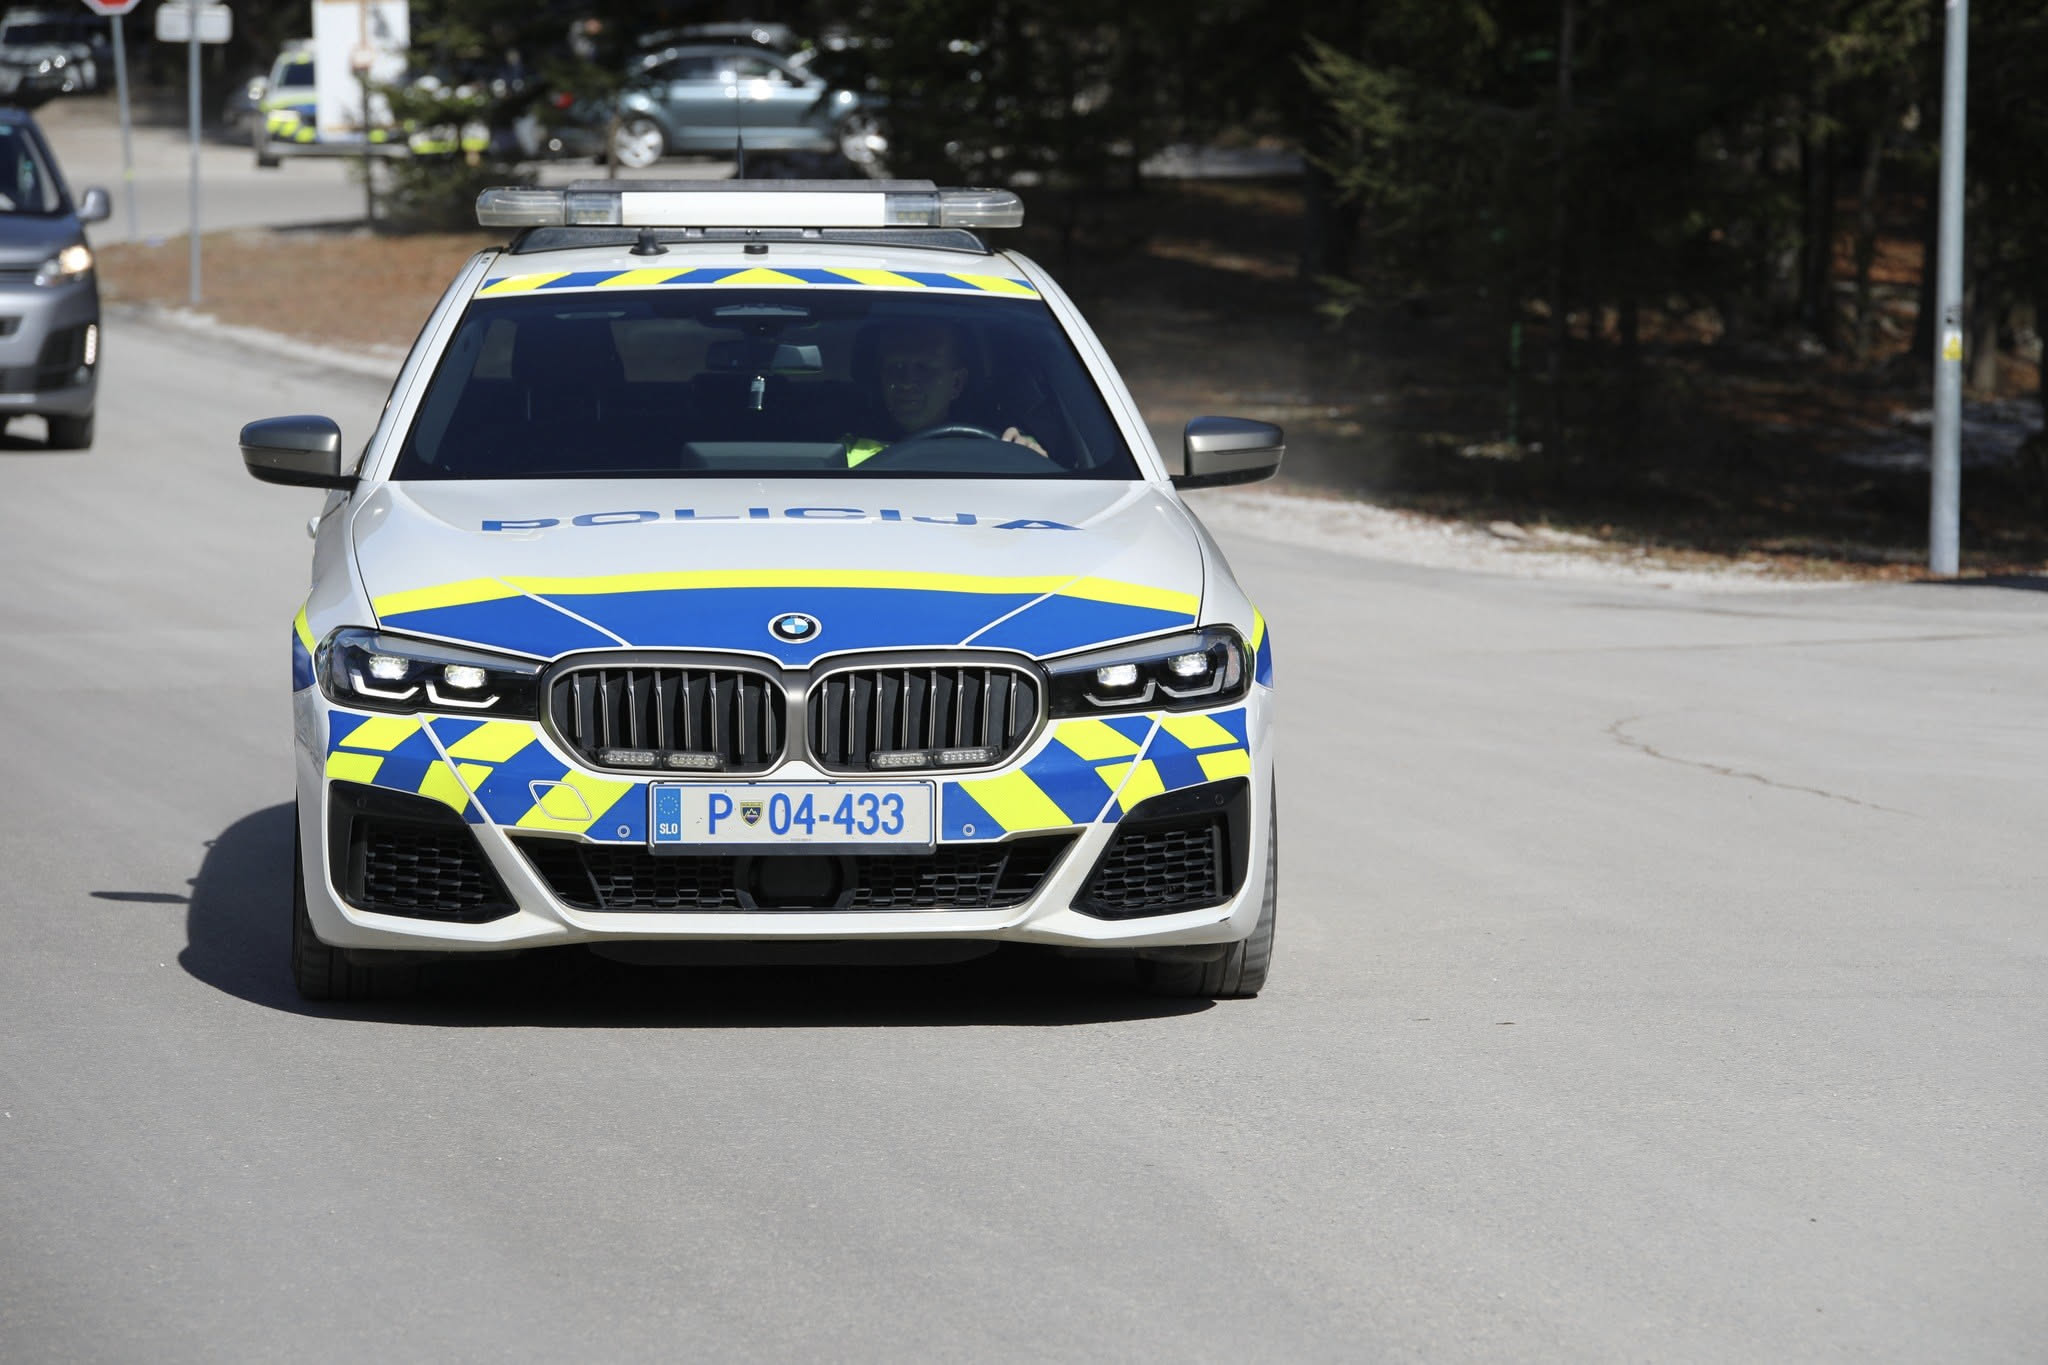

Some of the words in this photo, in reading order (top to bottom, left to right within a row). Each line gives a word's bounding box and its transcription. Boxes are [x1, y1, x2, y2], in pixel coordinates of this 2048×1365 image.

[481, 507, 1084, 531] POLICIJA
[708, 793, 733, 834] P
[768, 793, 904, 835] 04-433
[659, 823, 678, 835] SLO
